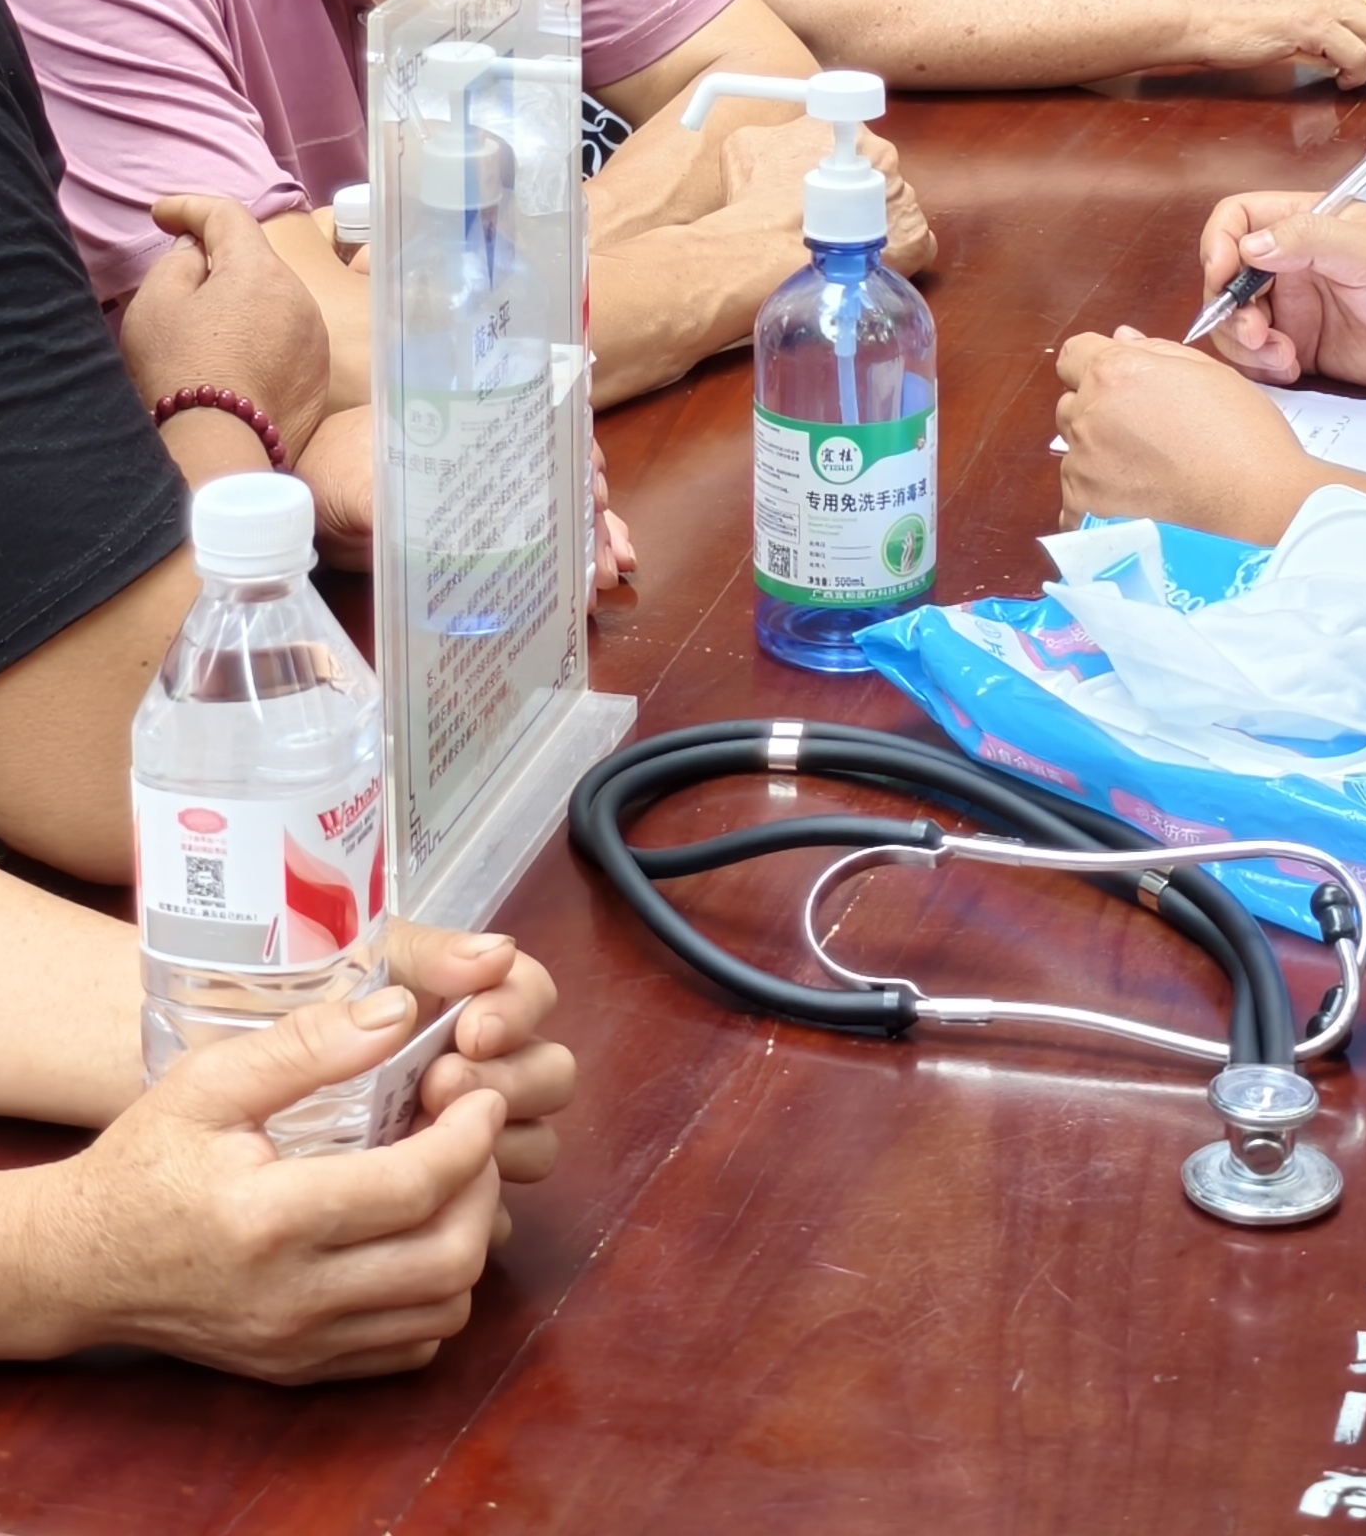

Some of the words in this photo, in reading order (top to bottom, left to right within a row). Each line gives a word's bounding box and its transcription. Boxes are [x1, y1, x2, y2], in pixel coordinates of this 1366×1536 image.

[806, 477, 927, 513] 专用免洗手消毒液
